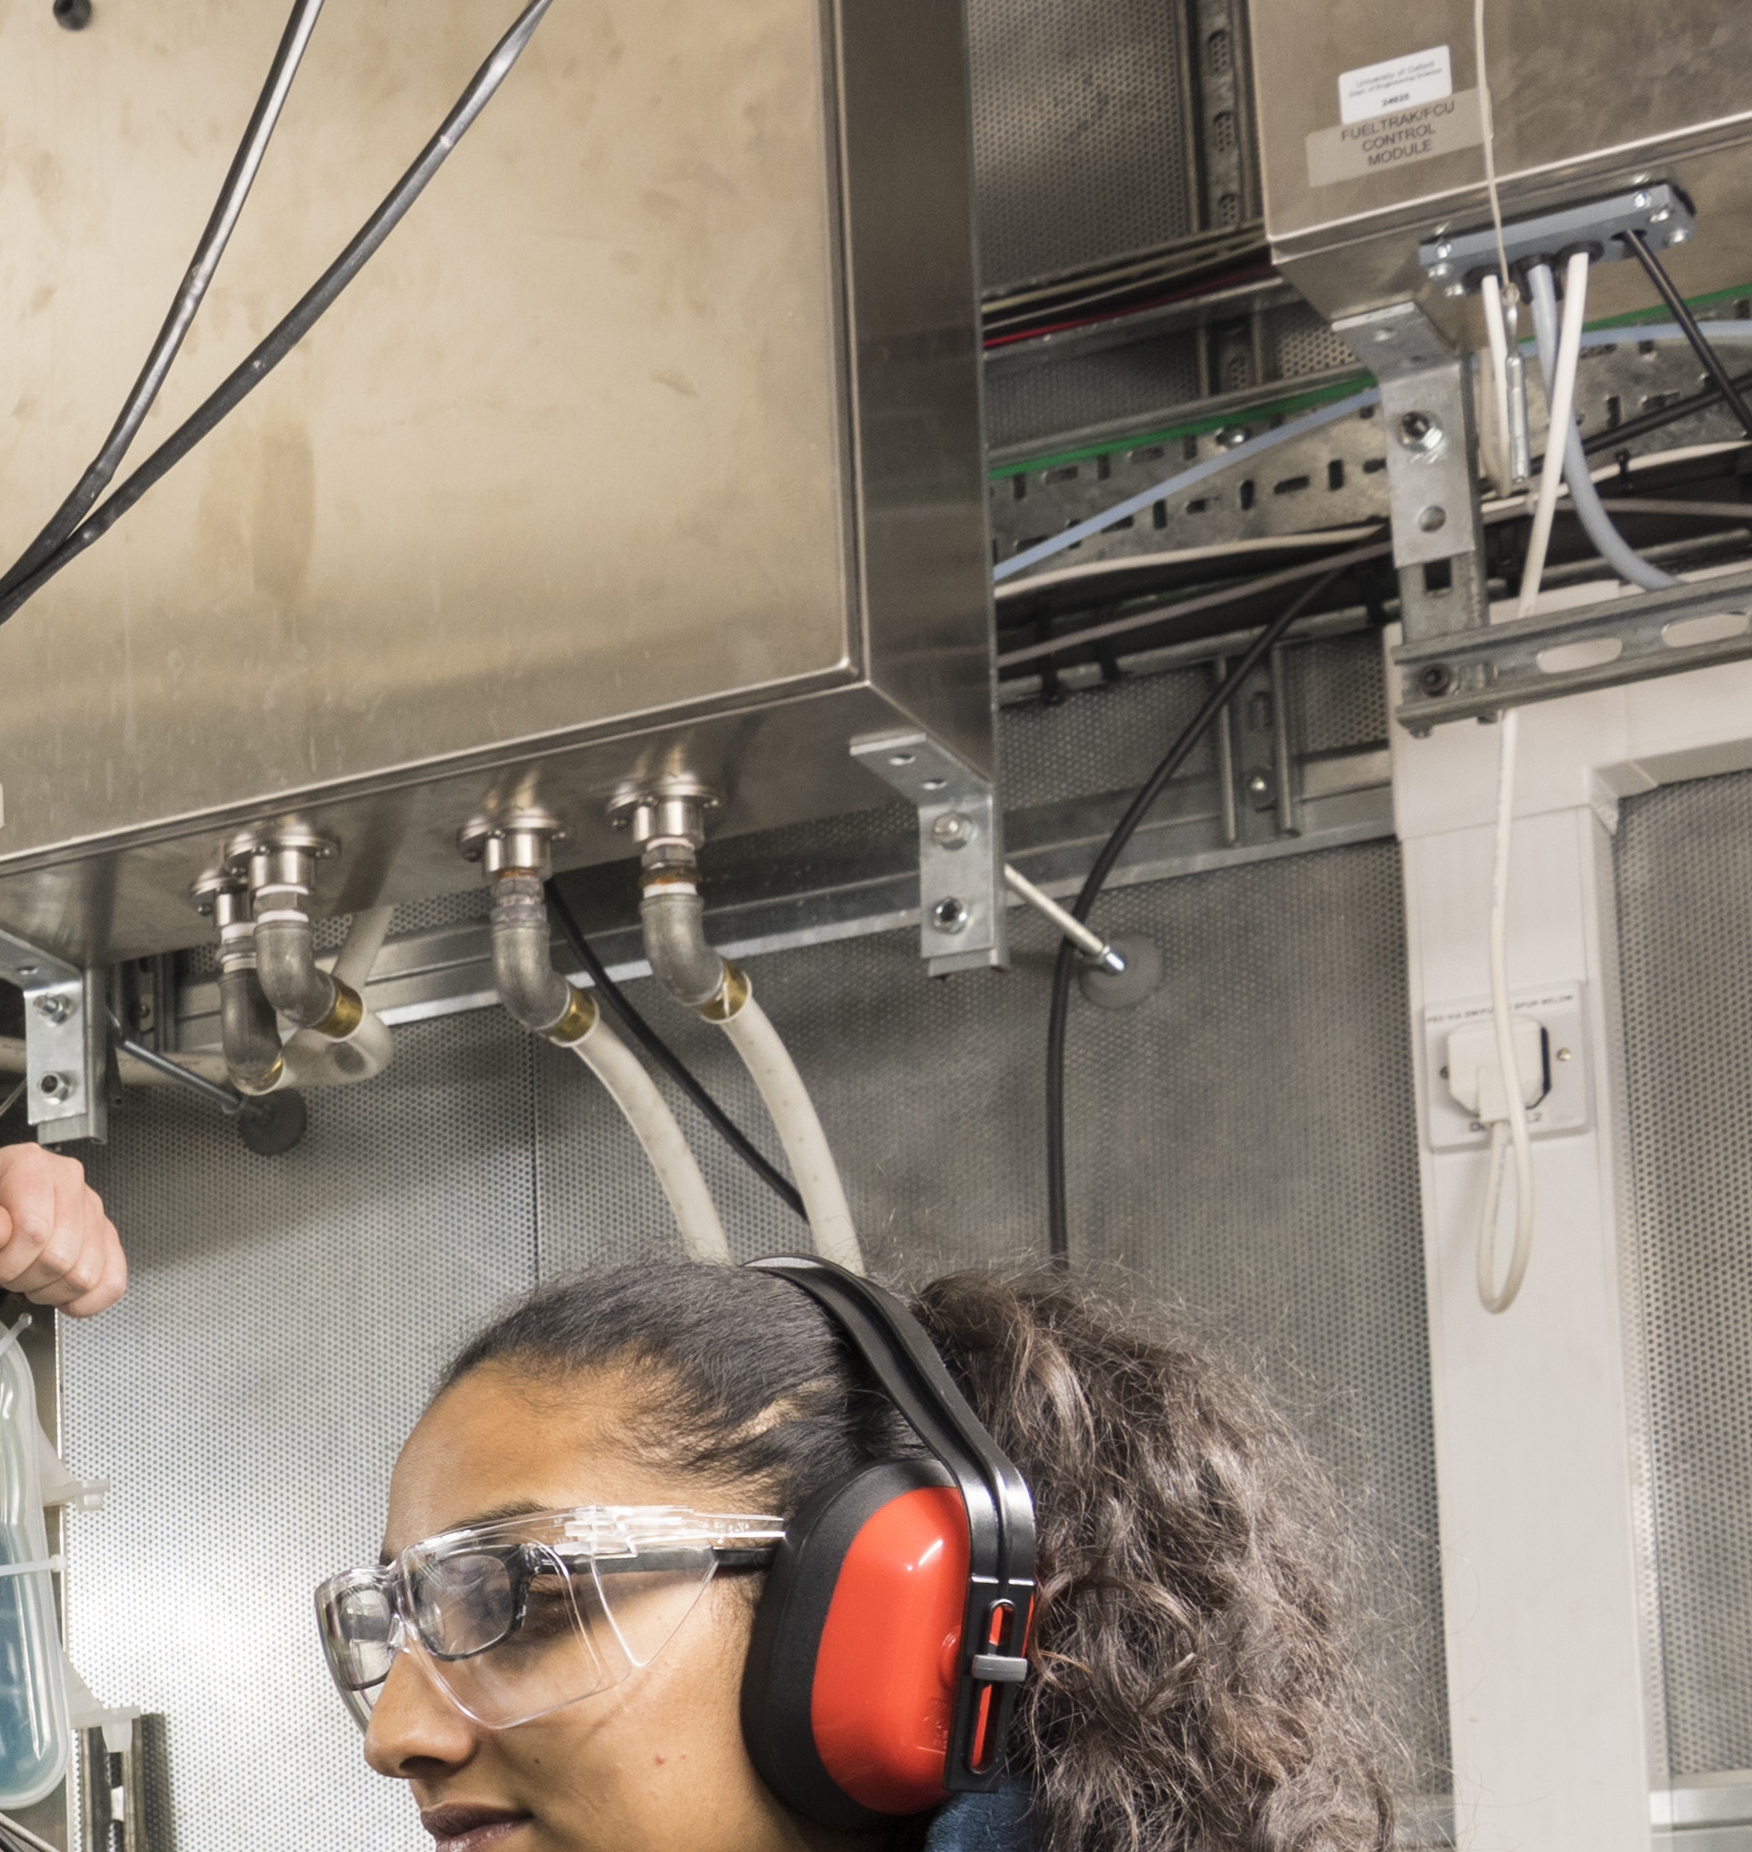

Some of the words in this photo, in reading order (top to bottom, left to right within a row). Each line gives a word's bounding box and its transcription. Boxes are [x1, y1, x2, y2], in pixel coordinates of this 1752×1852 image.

[1341, 101, 1455, 141] FUELTRAK/FCU
[1362, 122, 1436, 152] CONTROL
[1367, 140, 1432, 166] MODULE
